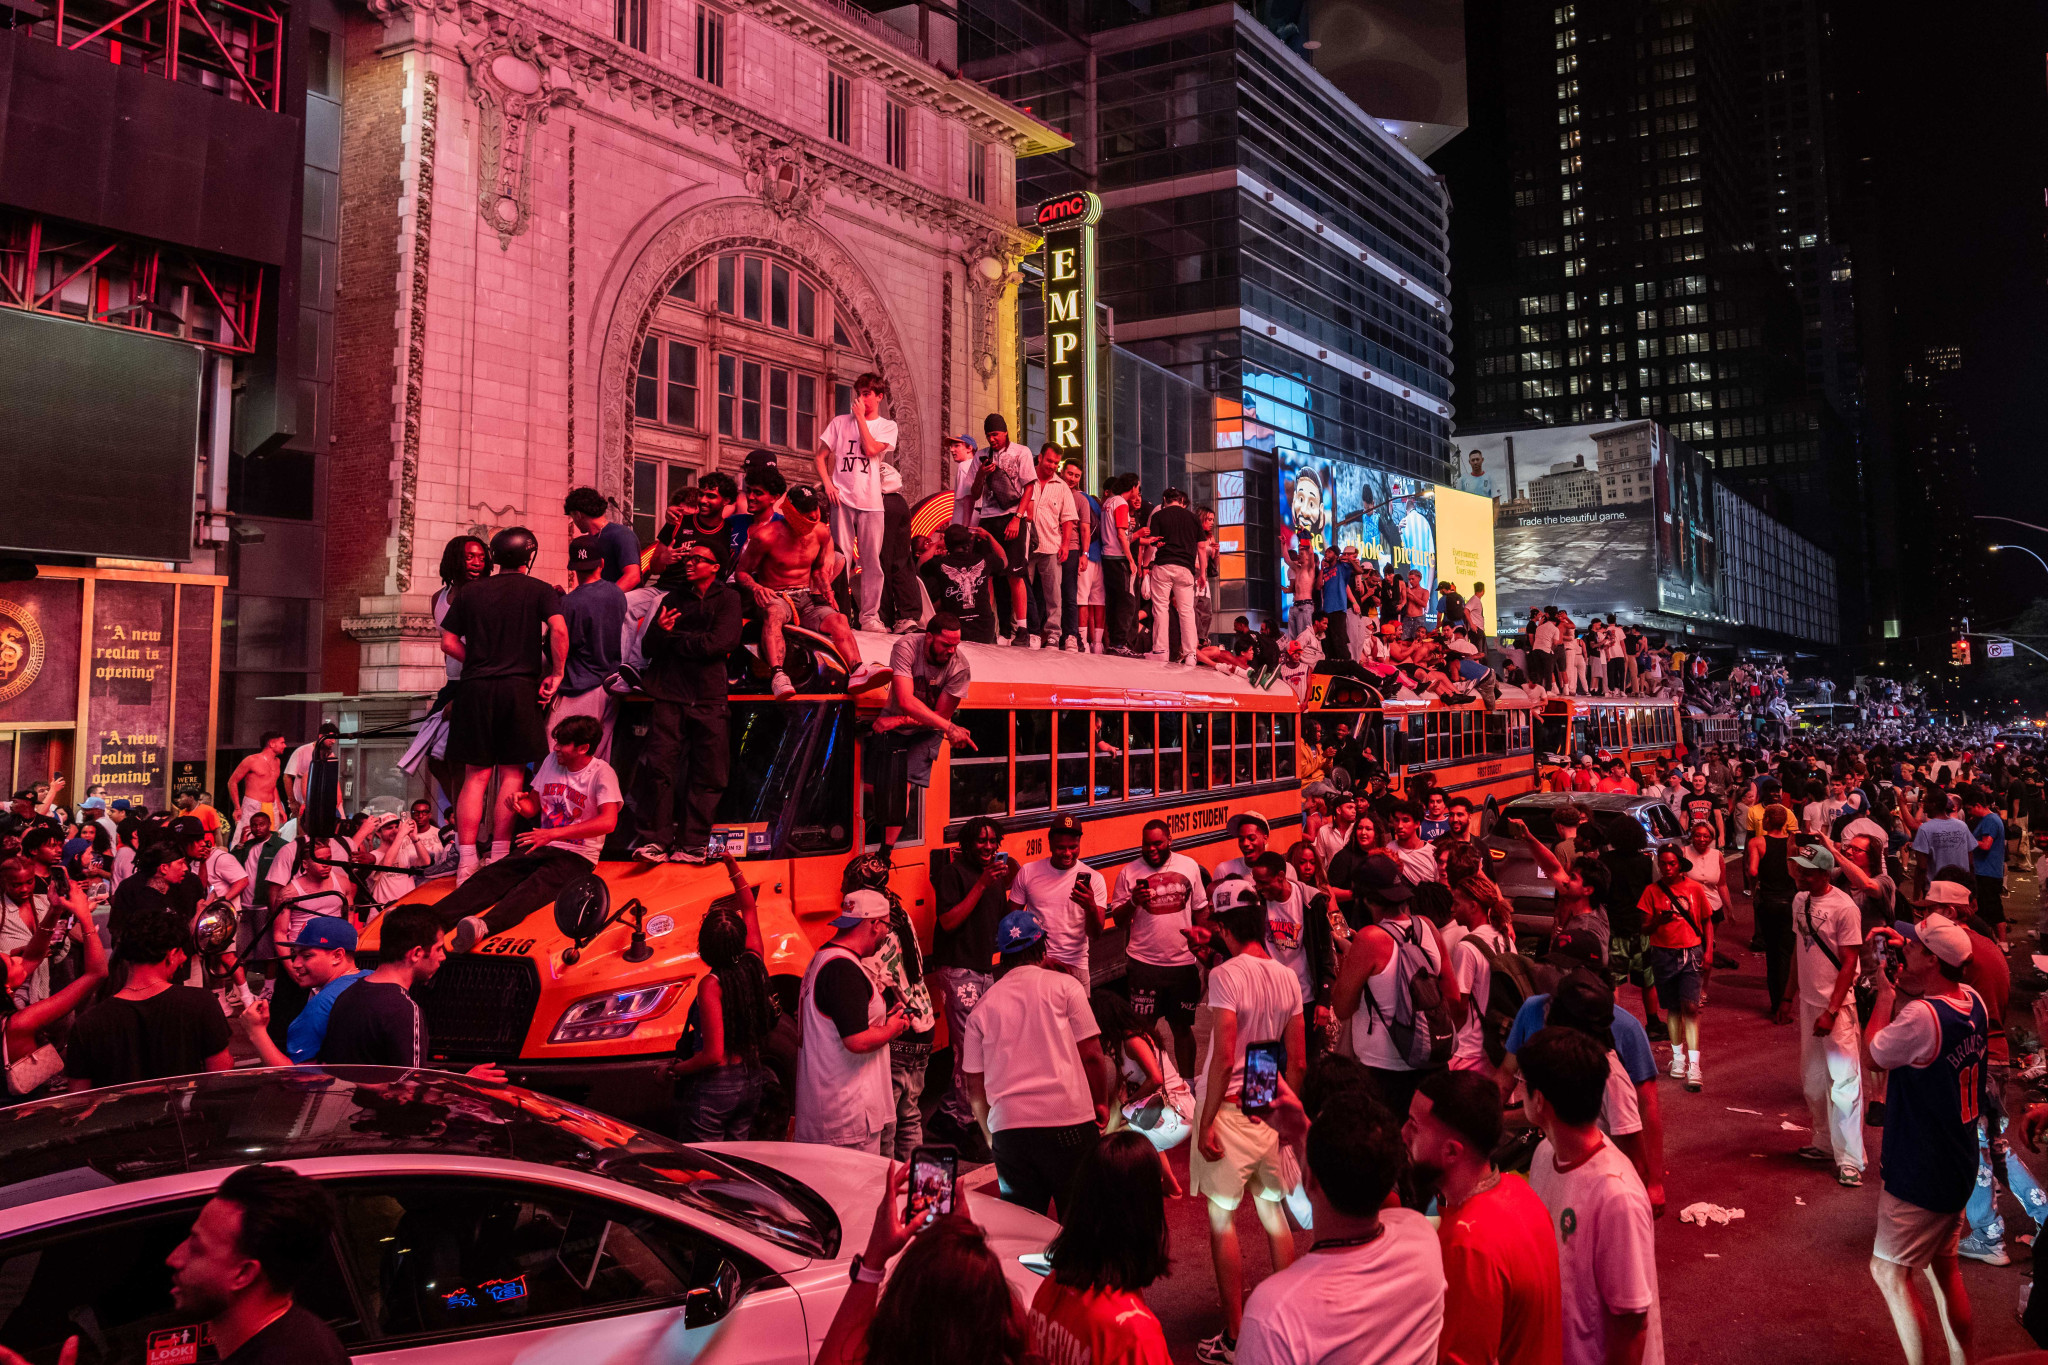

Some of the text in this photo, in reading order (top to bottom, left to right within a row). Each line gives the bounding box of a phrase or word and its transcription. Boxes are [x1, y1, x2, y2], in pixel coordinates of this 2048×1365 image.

[1048, 248, 1081, 472] EMPIR
[840, 456, 870, 474] NY
[1518, 512, 1627, 526] Trade the beautiful game.
[1393, 542, 1436, 569] picture
[132, 630, 162, 641] new
[96, 646, 160, 660] realm is
[127, 734, 157, 745] new
[92, 750, 156, 765] realm is
[543, 783, 567, 796] NEW
[1167, 806, 1229, 834] FIRST STUDENT
[1026, 838, 1042, 856] 2916
[1959, 1062, 1979, 1124] 11
[151, 1345, 194, 1361] LOOK!
